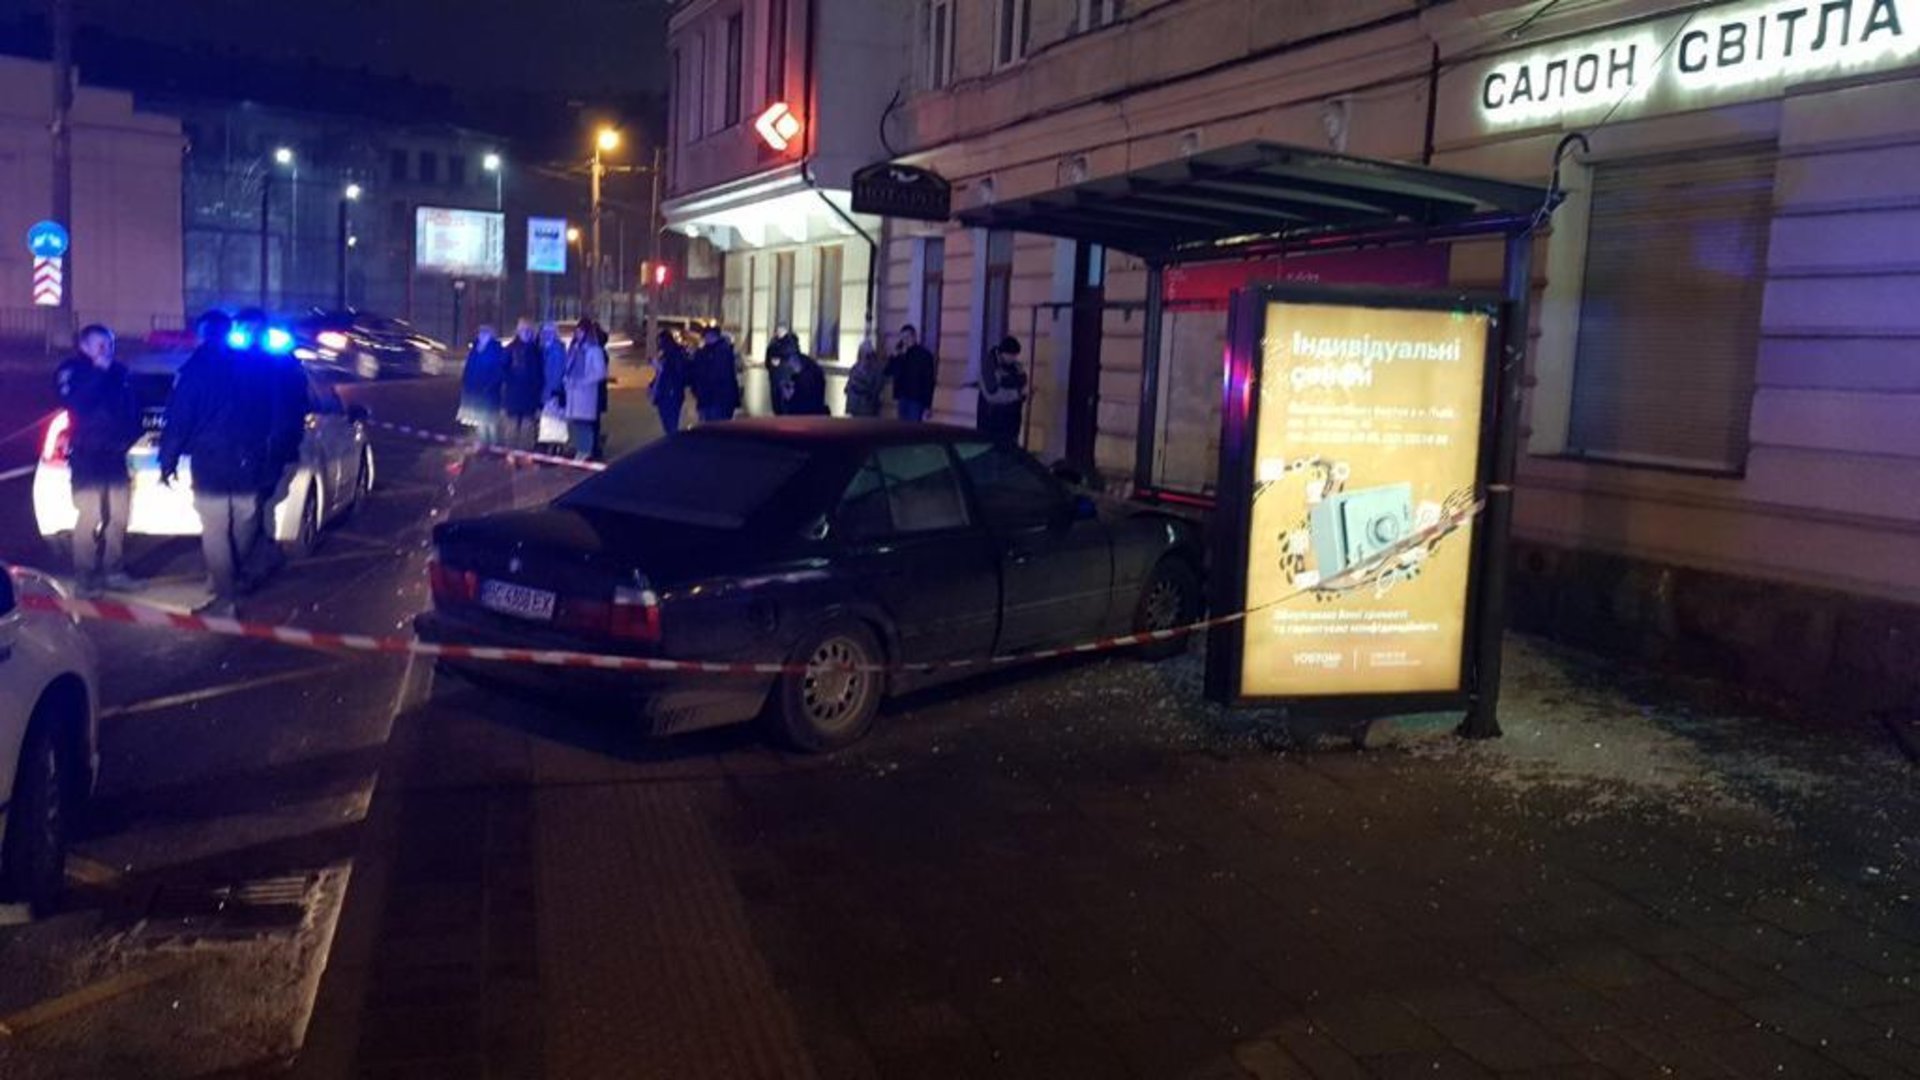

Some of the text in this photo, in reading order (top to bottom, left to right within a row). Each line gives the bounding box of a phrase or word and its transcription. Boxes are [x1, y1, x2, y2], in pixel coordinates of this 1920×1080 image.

[1483, 0, 1903, 110] САЛОН СВІТЛА
[1292, 331, 1461, 363] Індивідуальні
